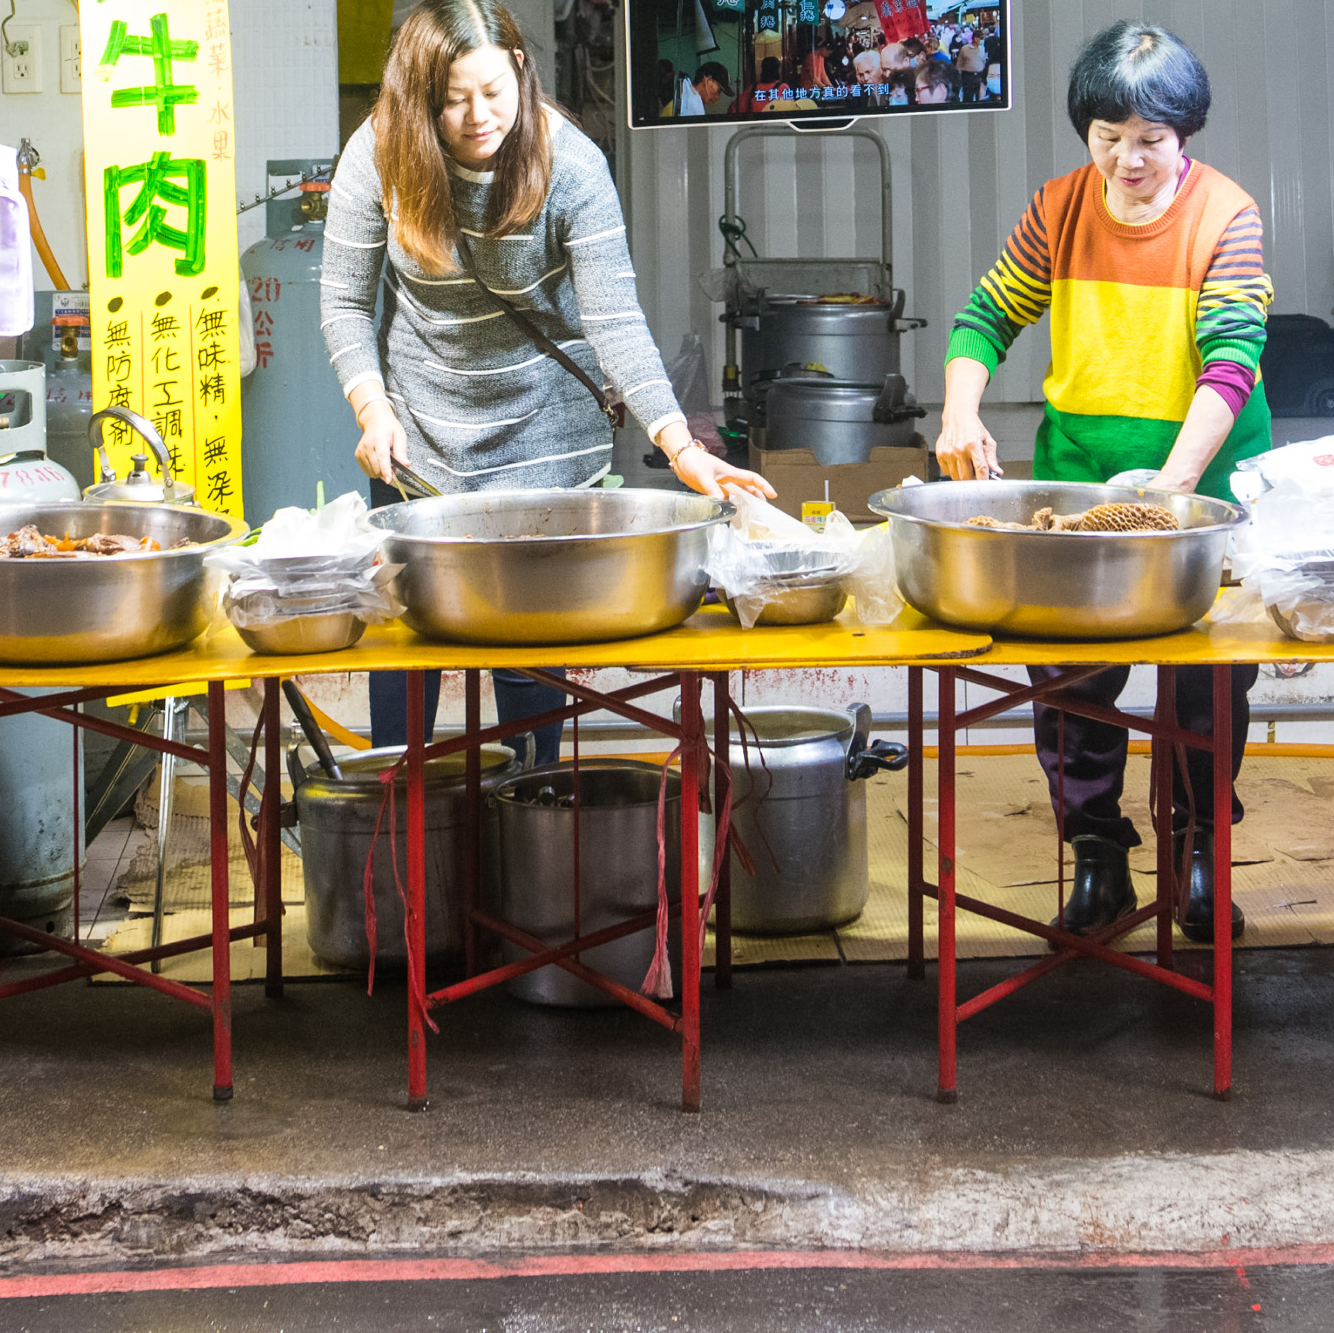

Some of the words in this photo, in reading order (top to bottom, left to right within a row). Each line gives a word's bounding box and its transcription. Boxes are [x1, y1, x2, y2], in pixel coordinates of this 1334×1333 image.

[754, 82, 890, 102] 在其他地方真的看不到
